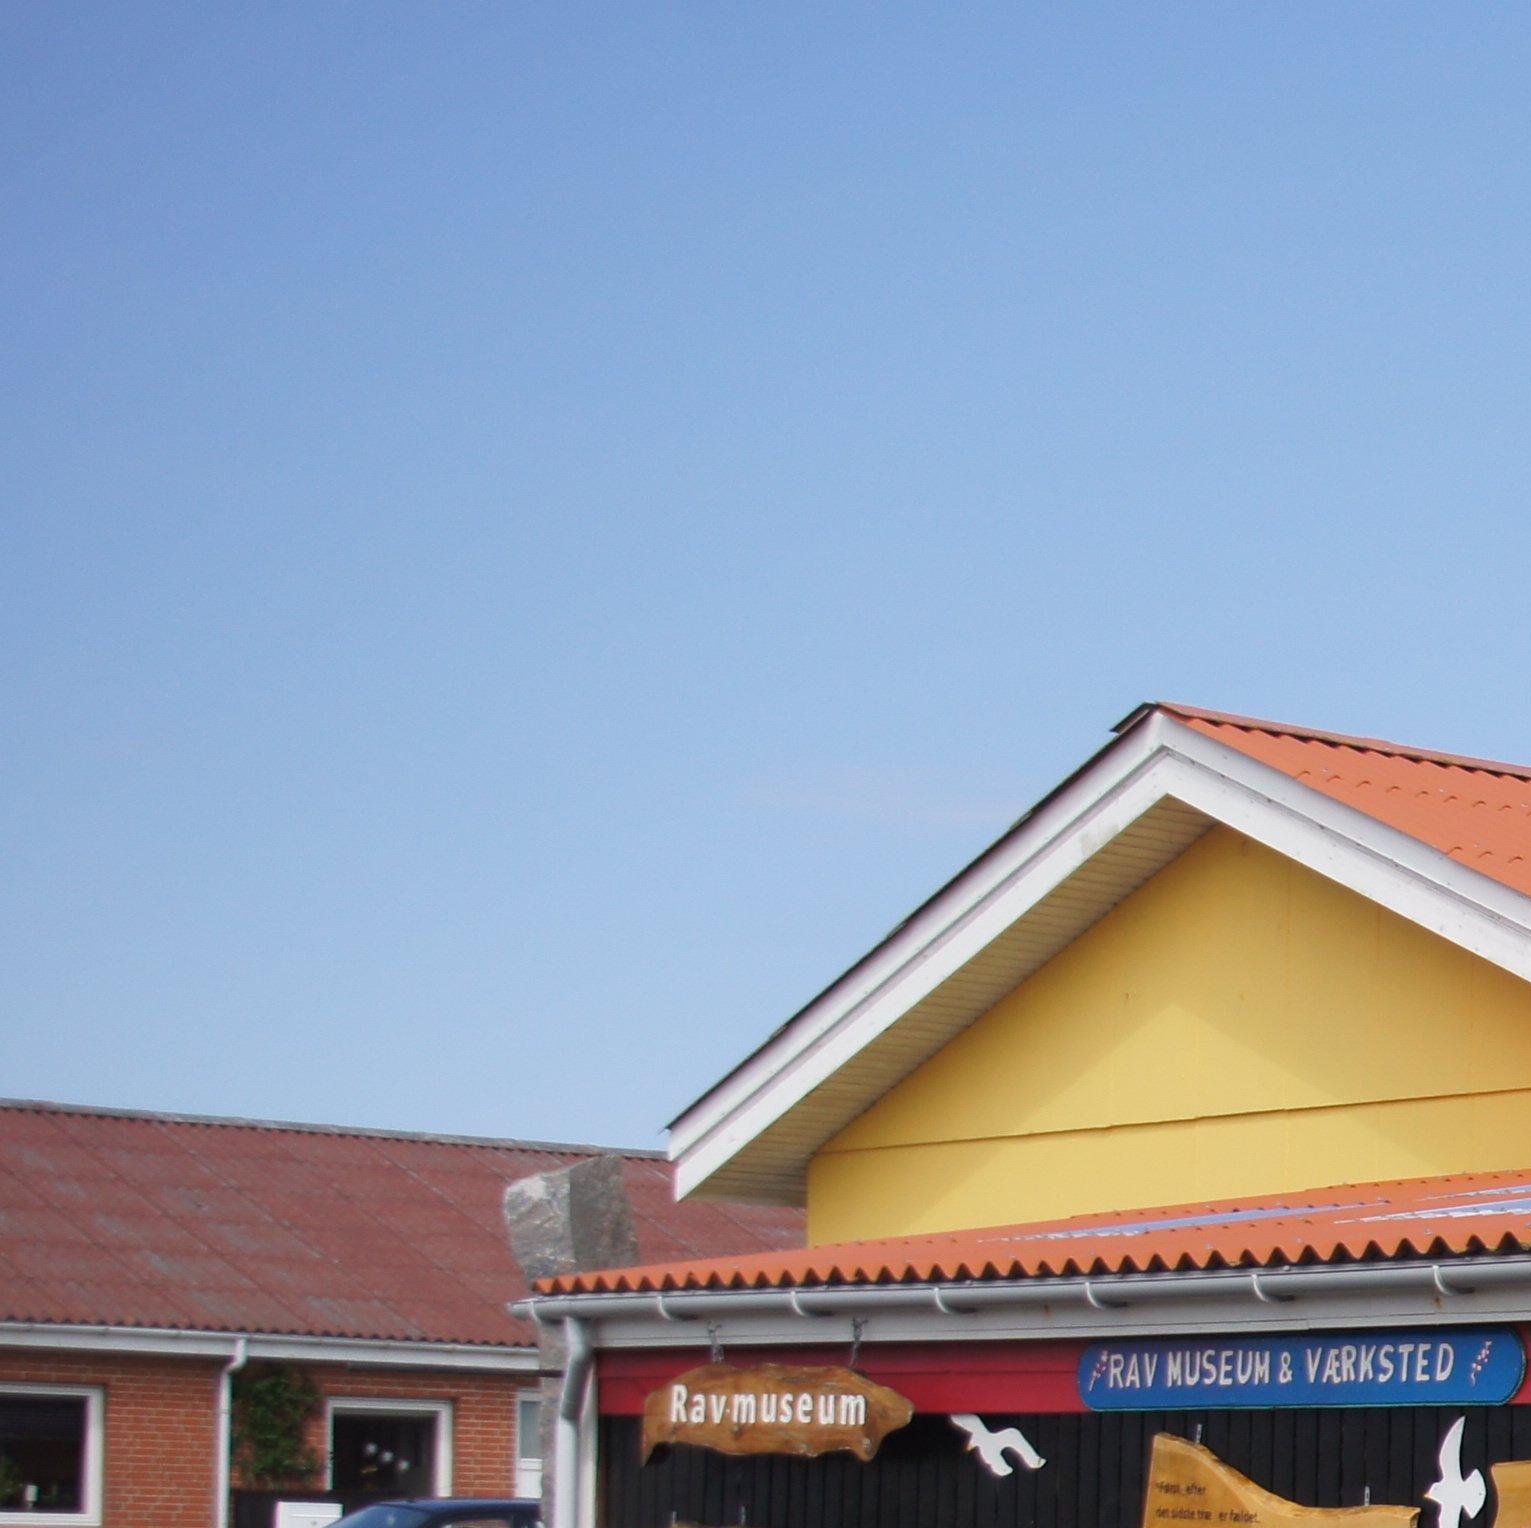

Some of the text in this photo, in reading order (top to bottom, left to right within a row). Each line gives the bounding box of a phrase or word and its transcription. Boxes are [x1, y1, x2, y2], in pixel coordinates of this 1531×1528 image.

[1108, 1343, 1455, 1389] RAV MUSEUM & VÆRKSTED
[670, 1384, 867, 1426] Ravmuseum
